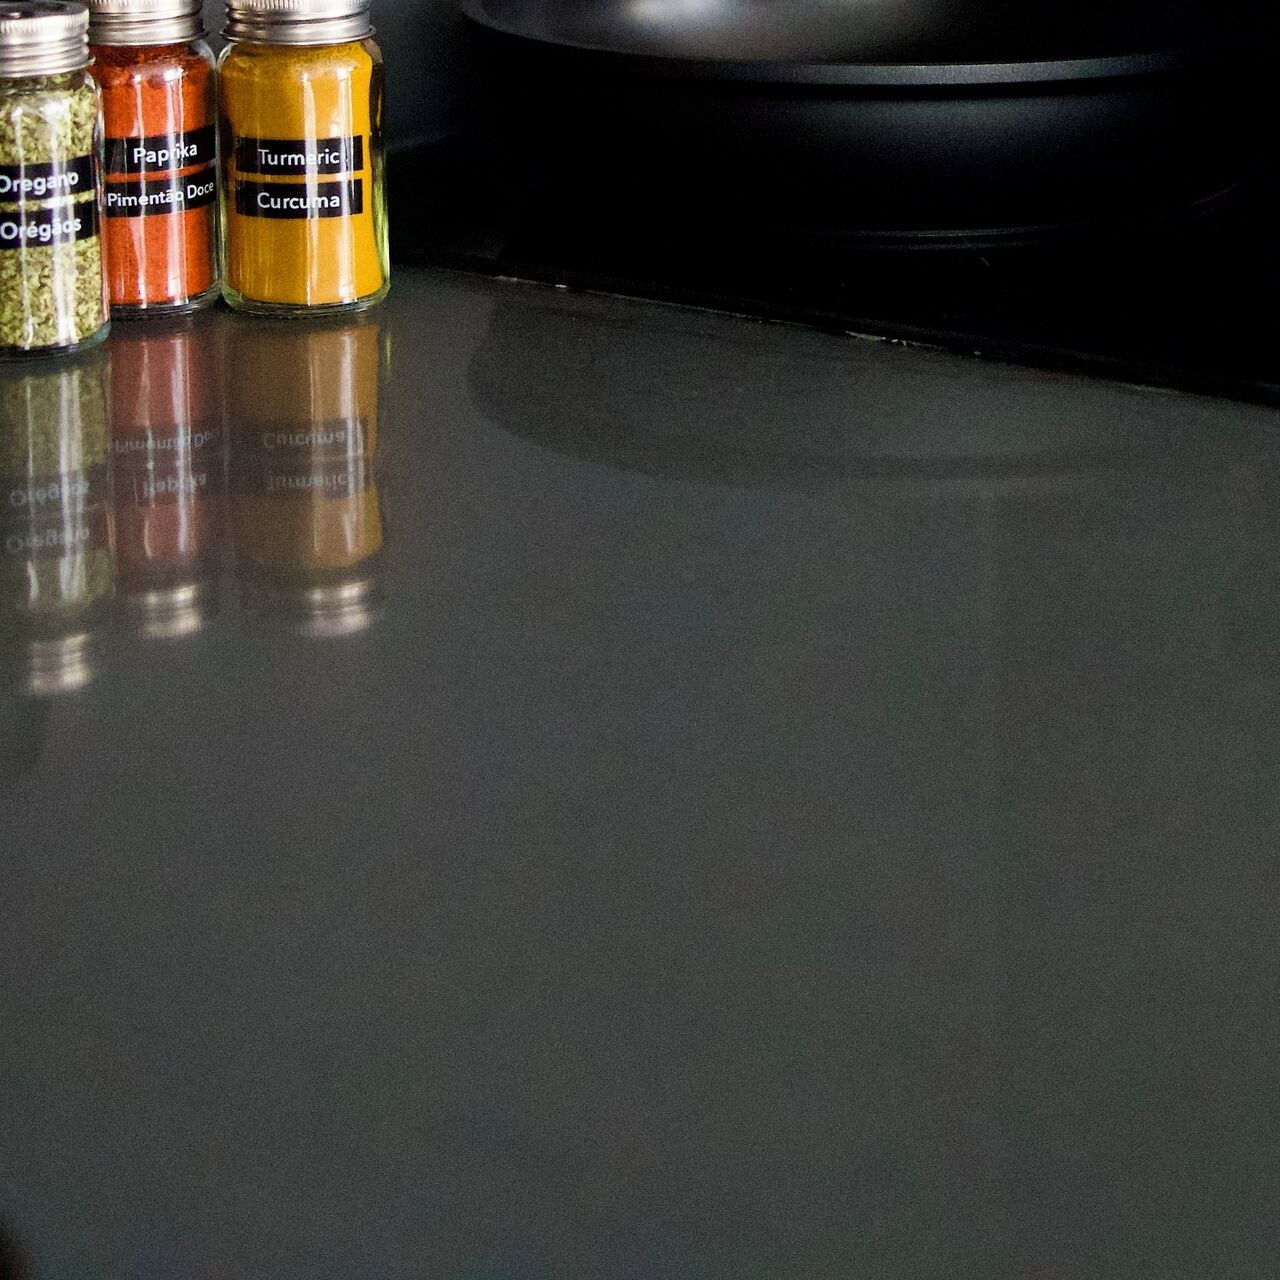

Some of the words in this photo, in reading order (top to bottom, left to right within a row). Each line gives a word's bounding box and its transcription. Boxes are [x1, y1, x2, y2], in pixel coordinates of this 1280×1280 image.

[133, 143, 198, 166] Paprika
[257, 148, 340, 166] Turmeric
[107, 188, 185, 207] Pimentão
[187, 182, 214, 199] Doce
[257, 192, 340, 209] Curcuma
